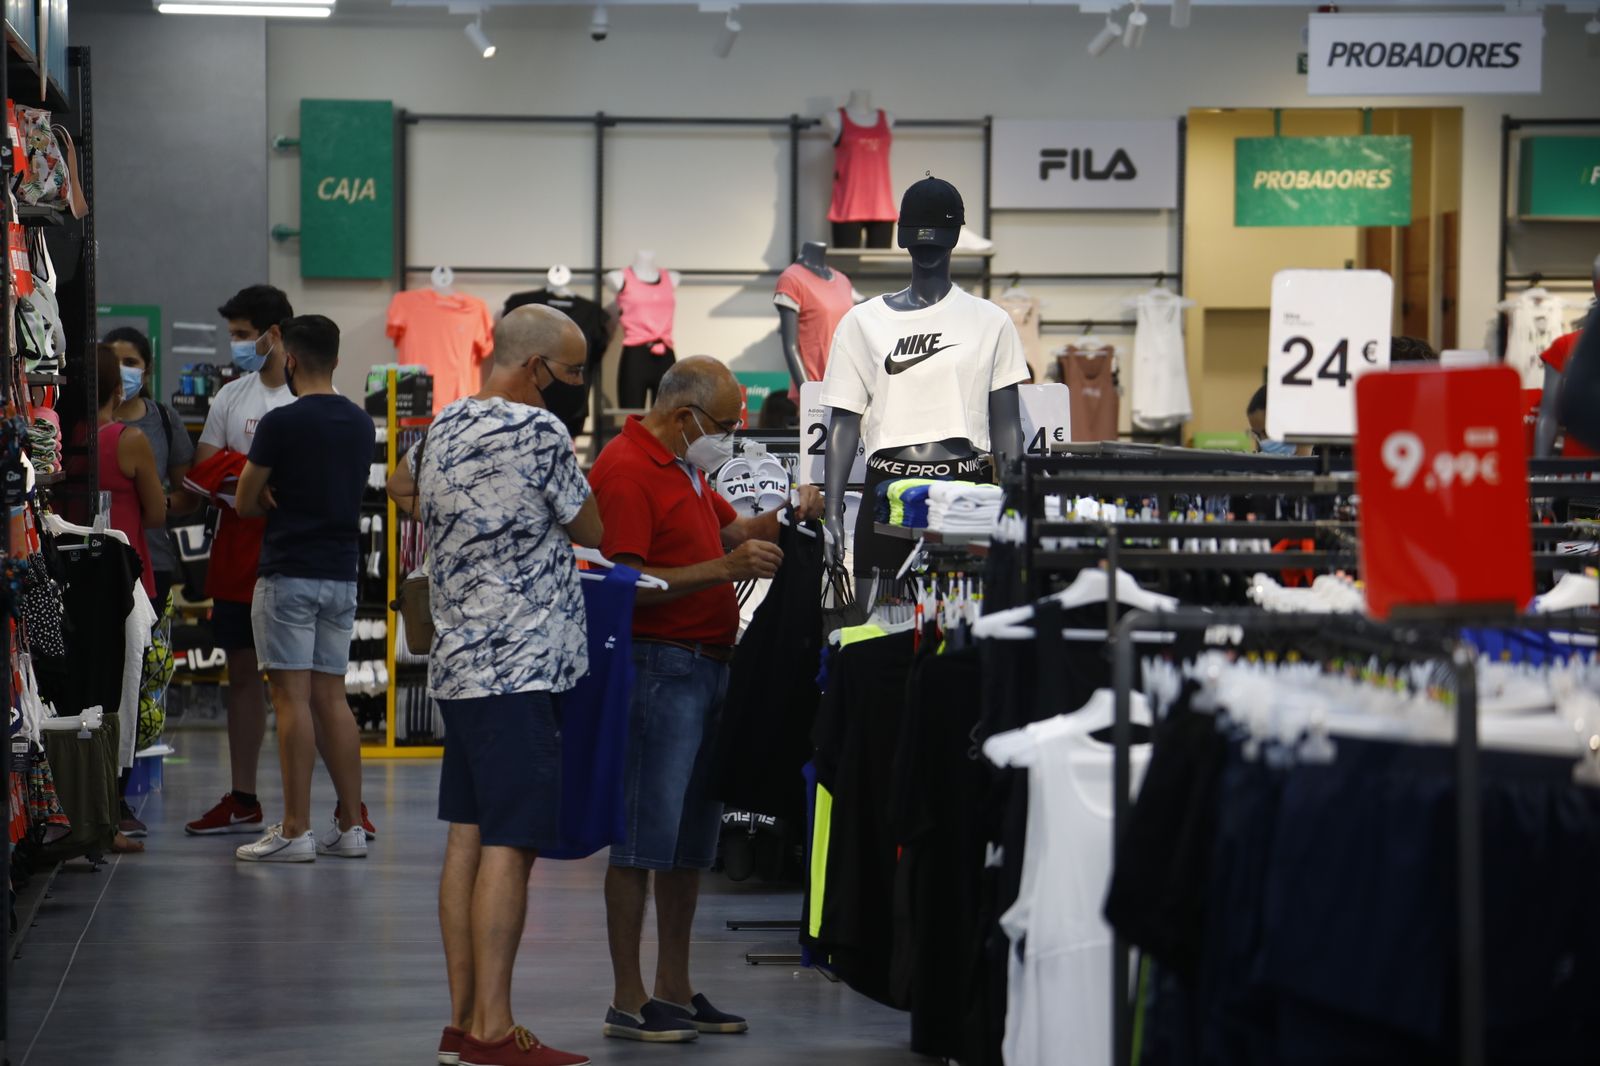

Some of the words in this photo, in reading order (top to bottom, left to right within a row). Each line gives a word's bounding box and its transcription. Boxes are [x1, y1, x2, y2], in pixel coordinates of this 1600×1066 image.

[1327, 41, 1521, 68] PROBADORES
[1039, 148, 1137, 181] FILA
[317, 176, 377, 203] CAJA
[1253, 169, 1393, 190] PROBADORES
[894, 333, 943, 355] NIKE
[868, 456, 905, 475] NIKE
[905, 464, 950, 477] PRO
[727, 482, 756, 495] FILA
[758, 480, 787, 493] FILA
[172, 647, 226, 671] FILA
